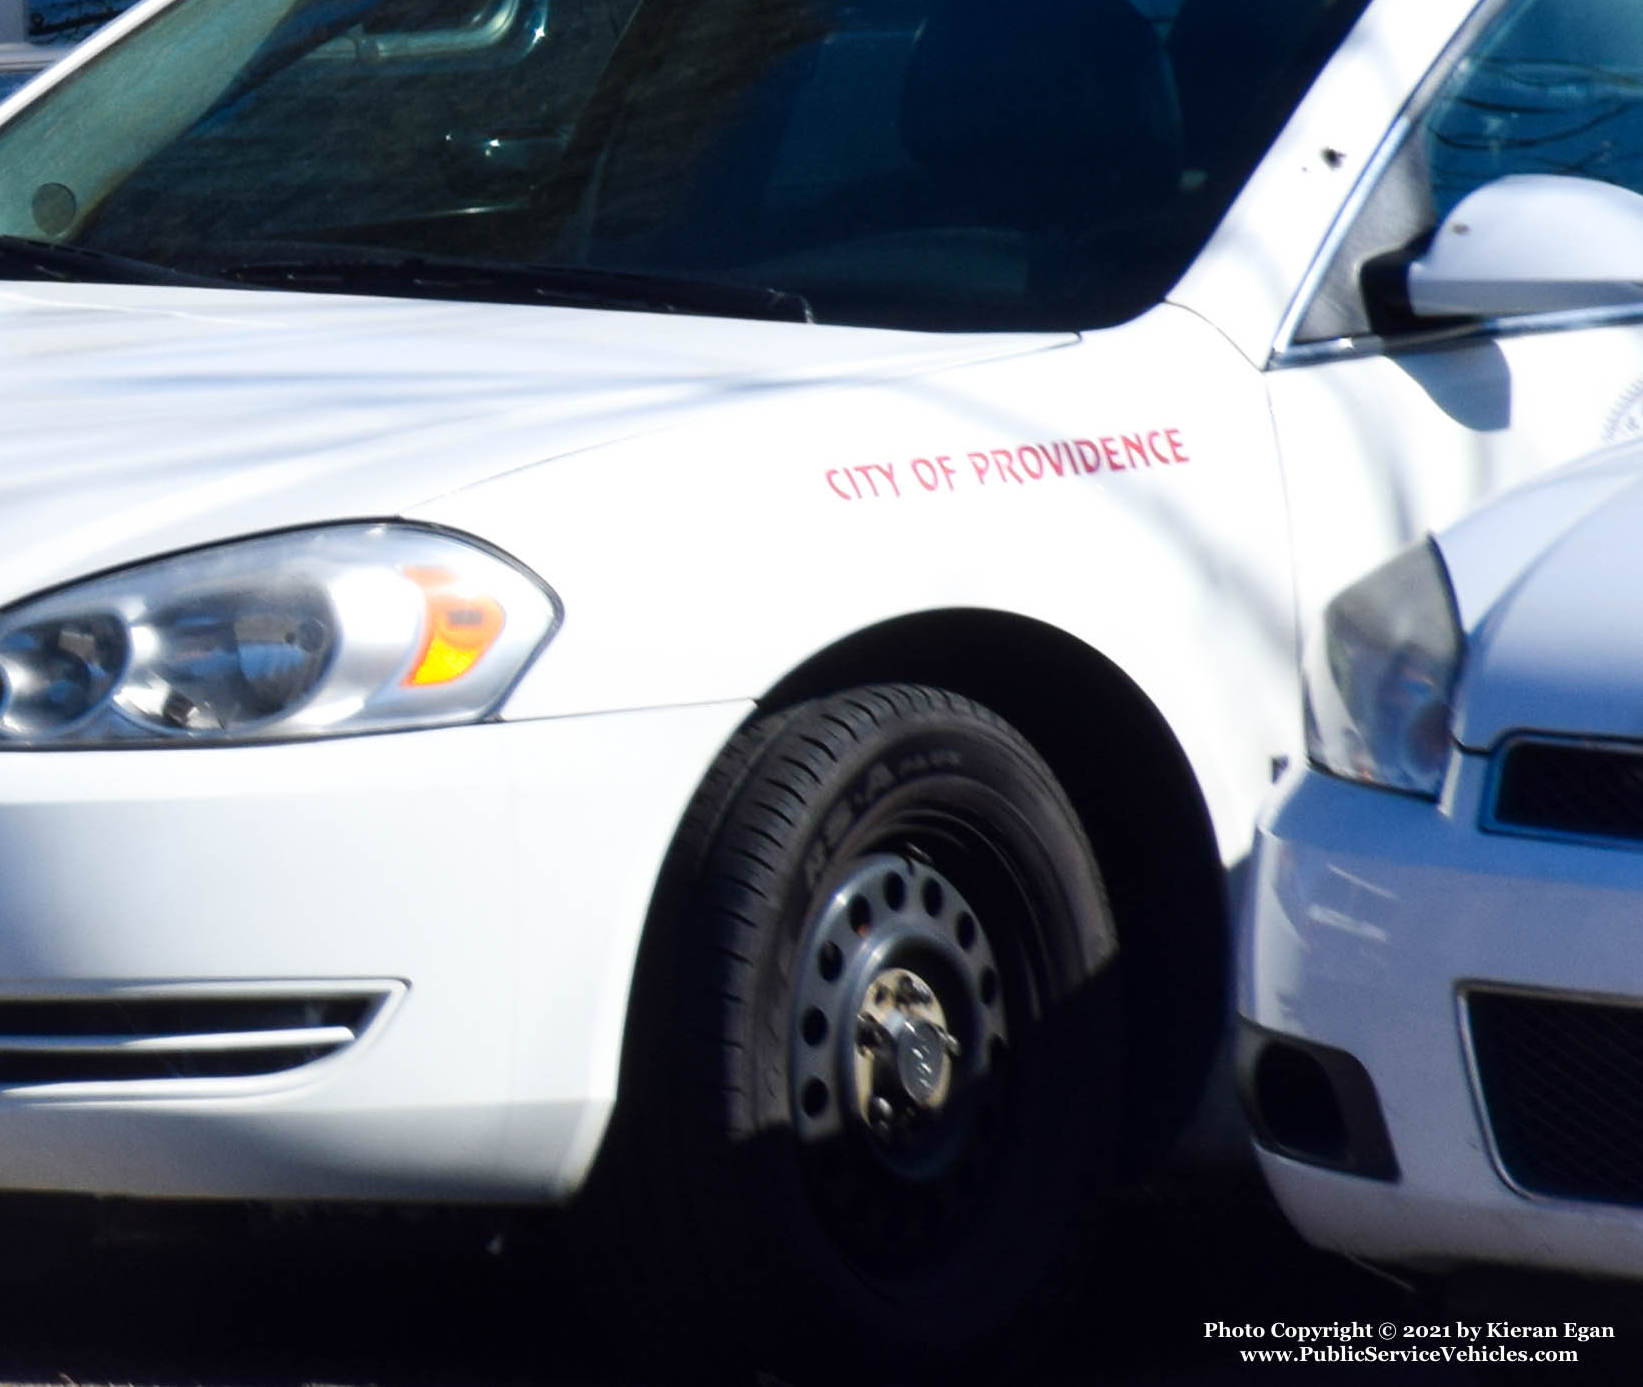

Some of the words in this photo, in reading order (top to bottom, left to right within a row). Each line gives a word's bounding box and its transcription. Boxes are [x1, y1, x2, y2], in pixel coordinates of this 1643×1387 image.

[825, 462, 901, 501] CITY
[910, 456, 957, 492] OF
[966, 427, 1191, 486] PROVIDENCE
